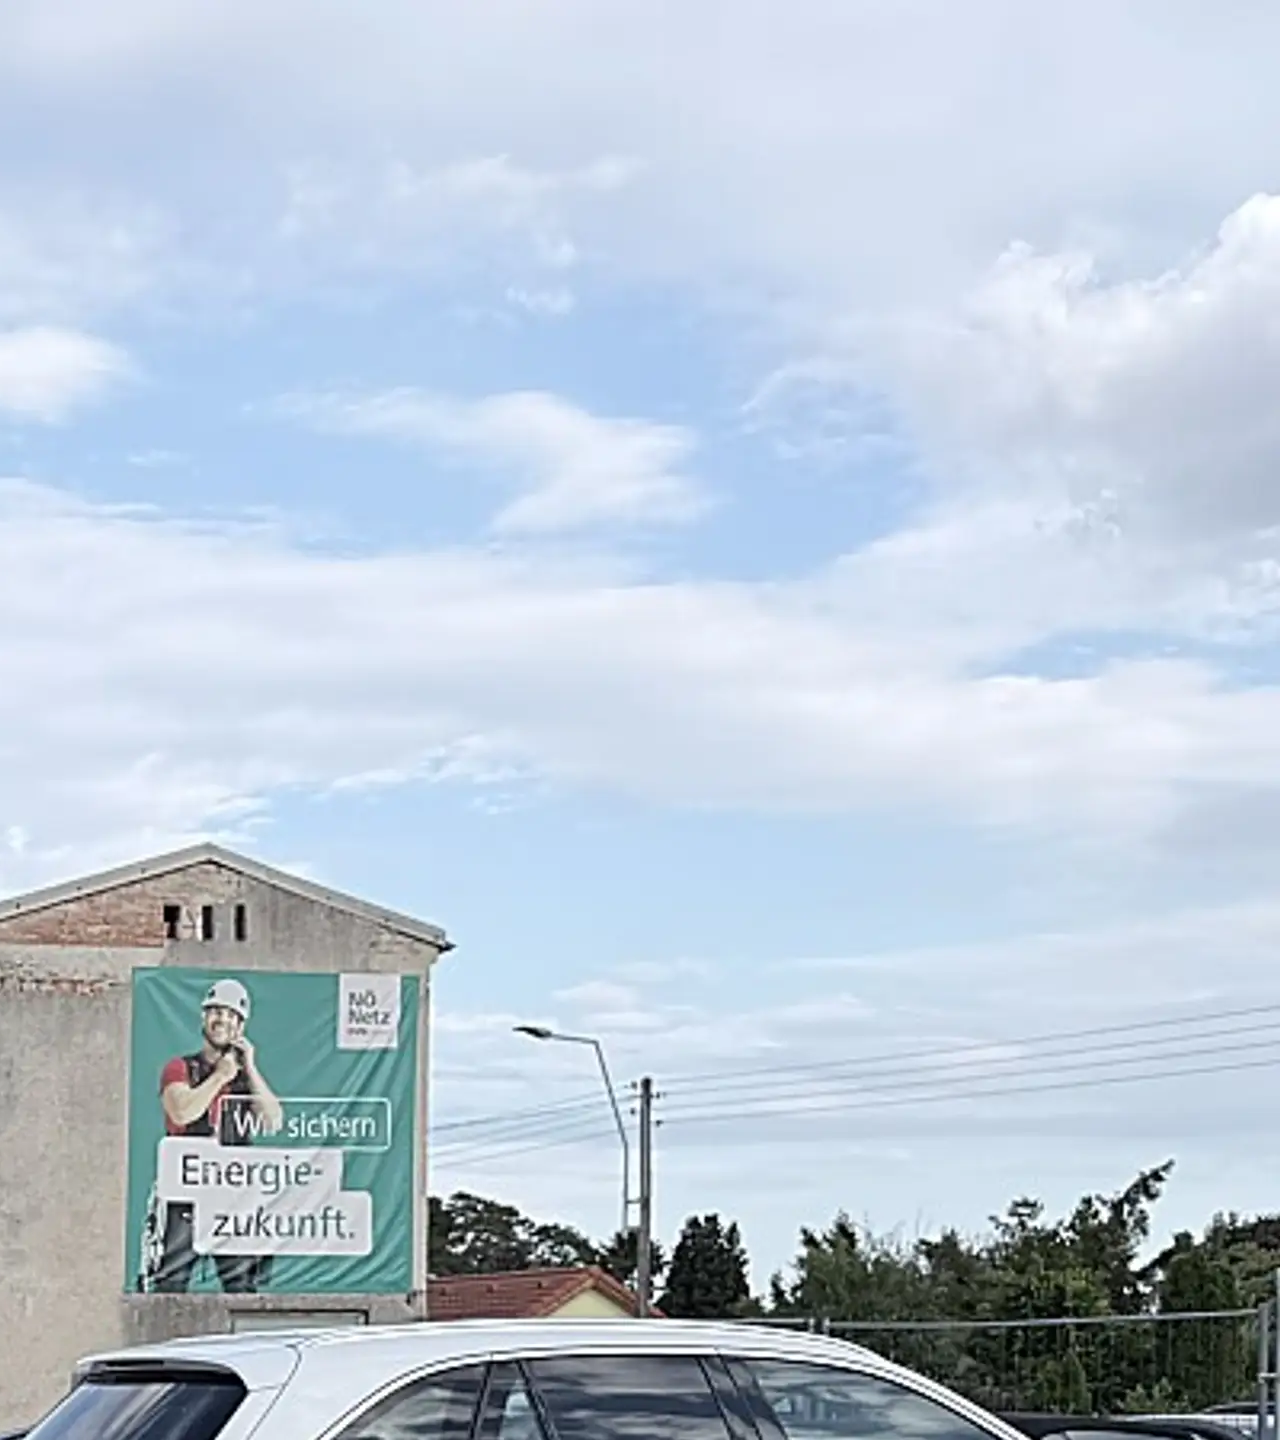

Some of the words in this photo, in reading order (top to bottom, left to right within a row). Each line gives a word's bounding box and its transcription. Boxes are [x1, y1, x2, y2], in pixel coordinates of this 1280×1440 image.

[348, 1009, 390, 1025] Netz
[287, 1112, 376, 1138] sichern
[182, 1155, 323, 1194] Energie-
[212, 1206, 355, 1240] zukunft.
